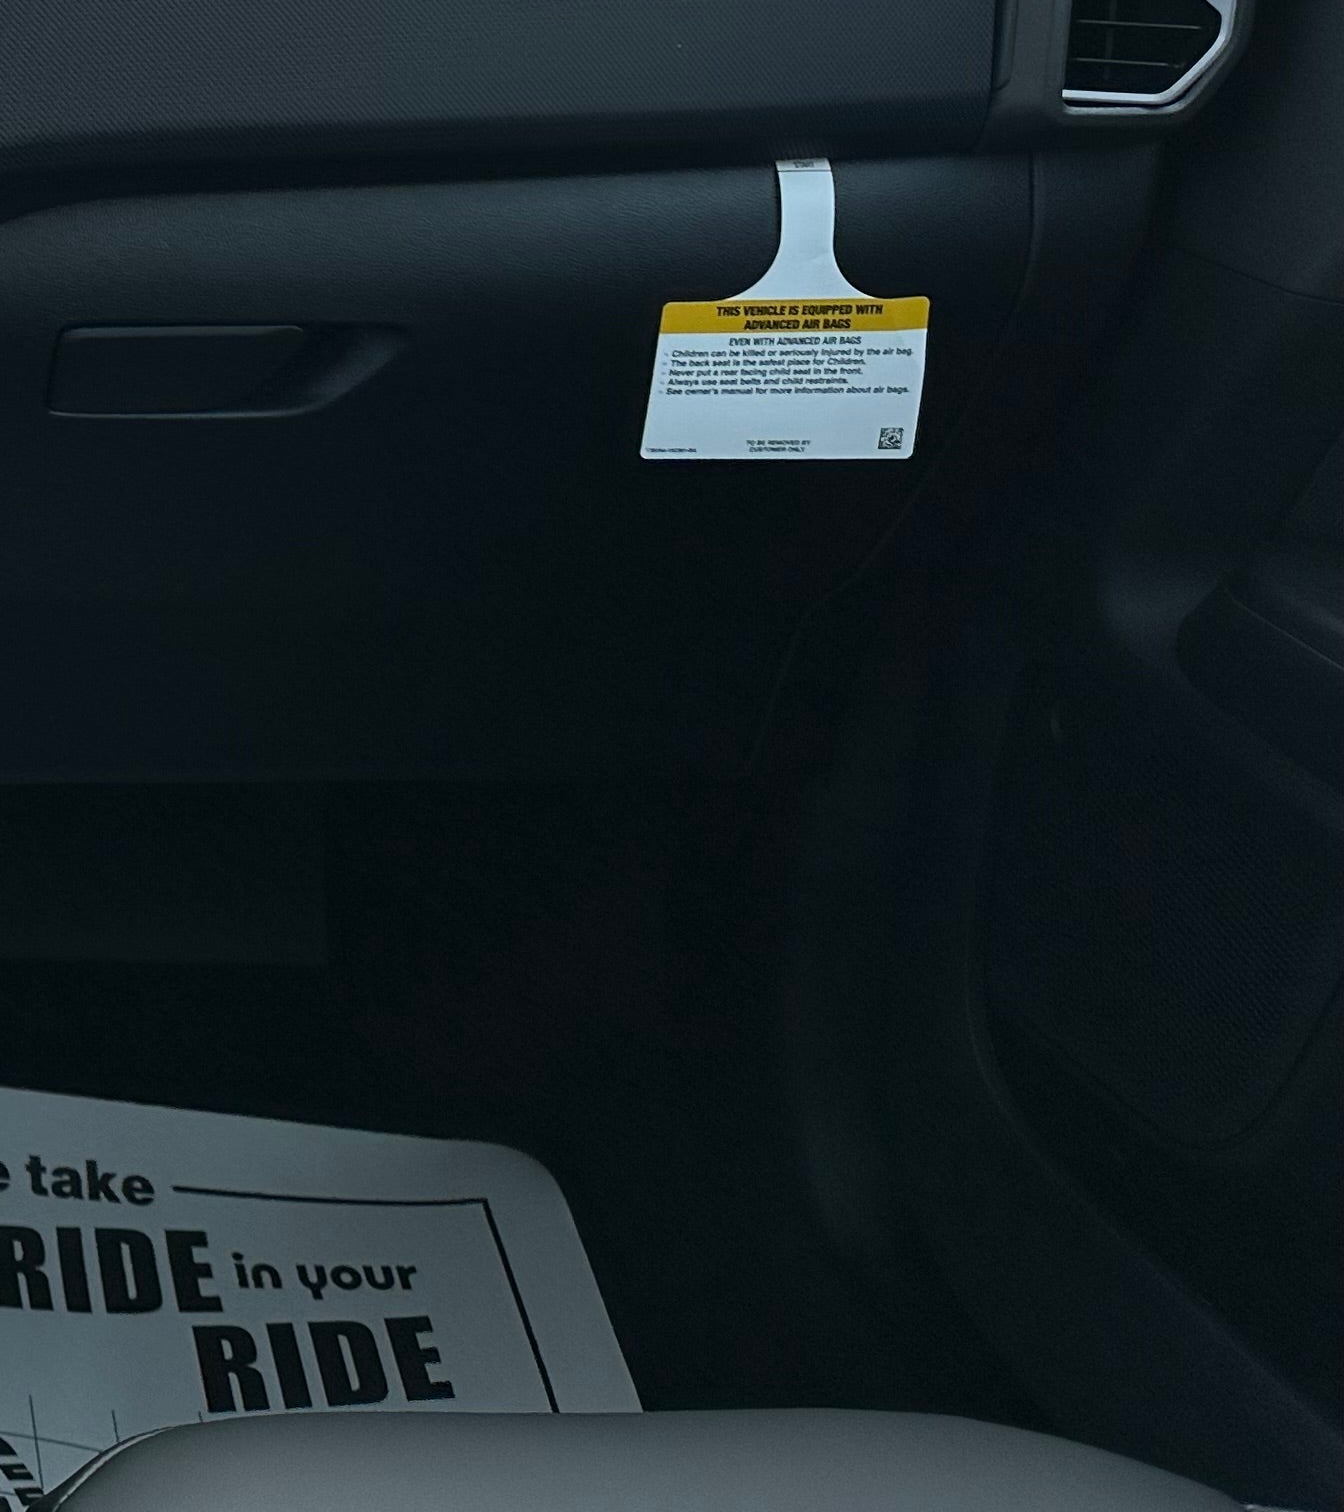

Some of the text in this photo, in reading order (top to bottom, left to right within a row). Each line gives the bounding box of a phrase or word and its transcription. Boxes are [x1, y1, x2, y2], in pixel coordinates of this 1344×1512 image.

[717, 304, 883, 316] THIS VEHICLE IS EQUIPPED WITH
[744, 319, 851, 330] ADVANCED AIR BAGS
[729, 336, 862, 346] EVEN WITH ADVANCED AIR BAGS
[26, 1153, 156, 1208] take
[232, 1250, 283, 1289] in
[295, 1258, 418, 1301] your
[190, 1314, 458, 1414] RIDE
